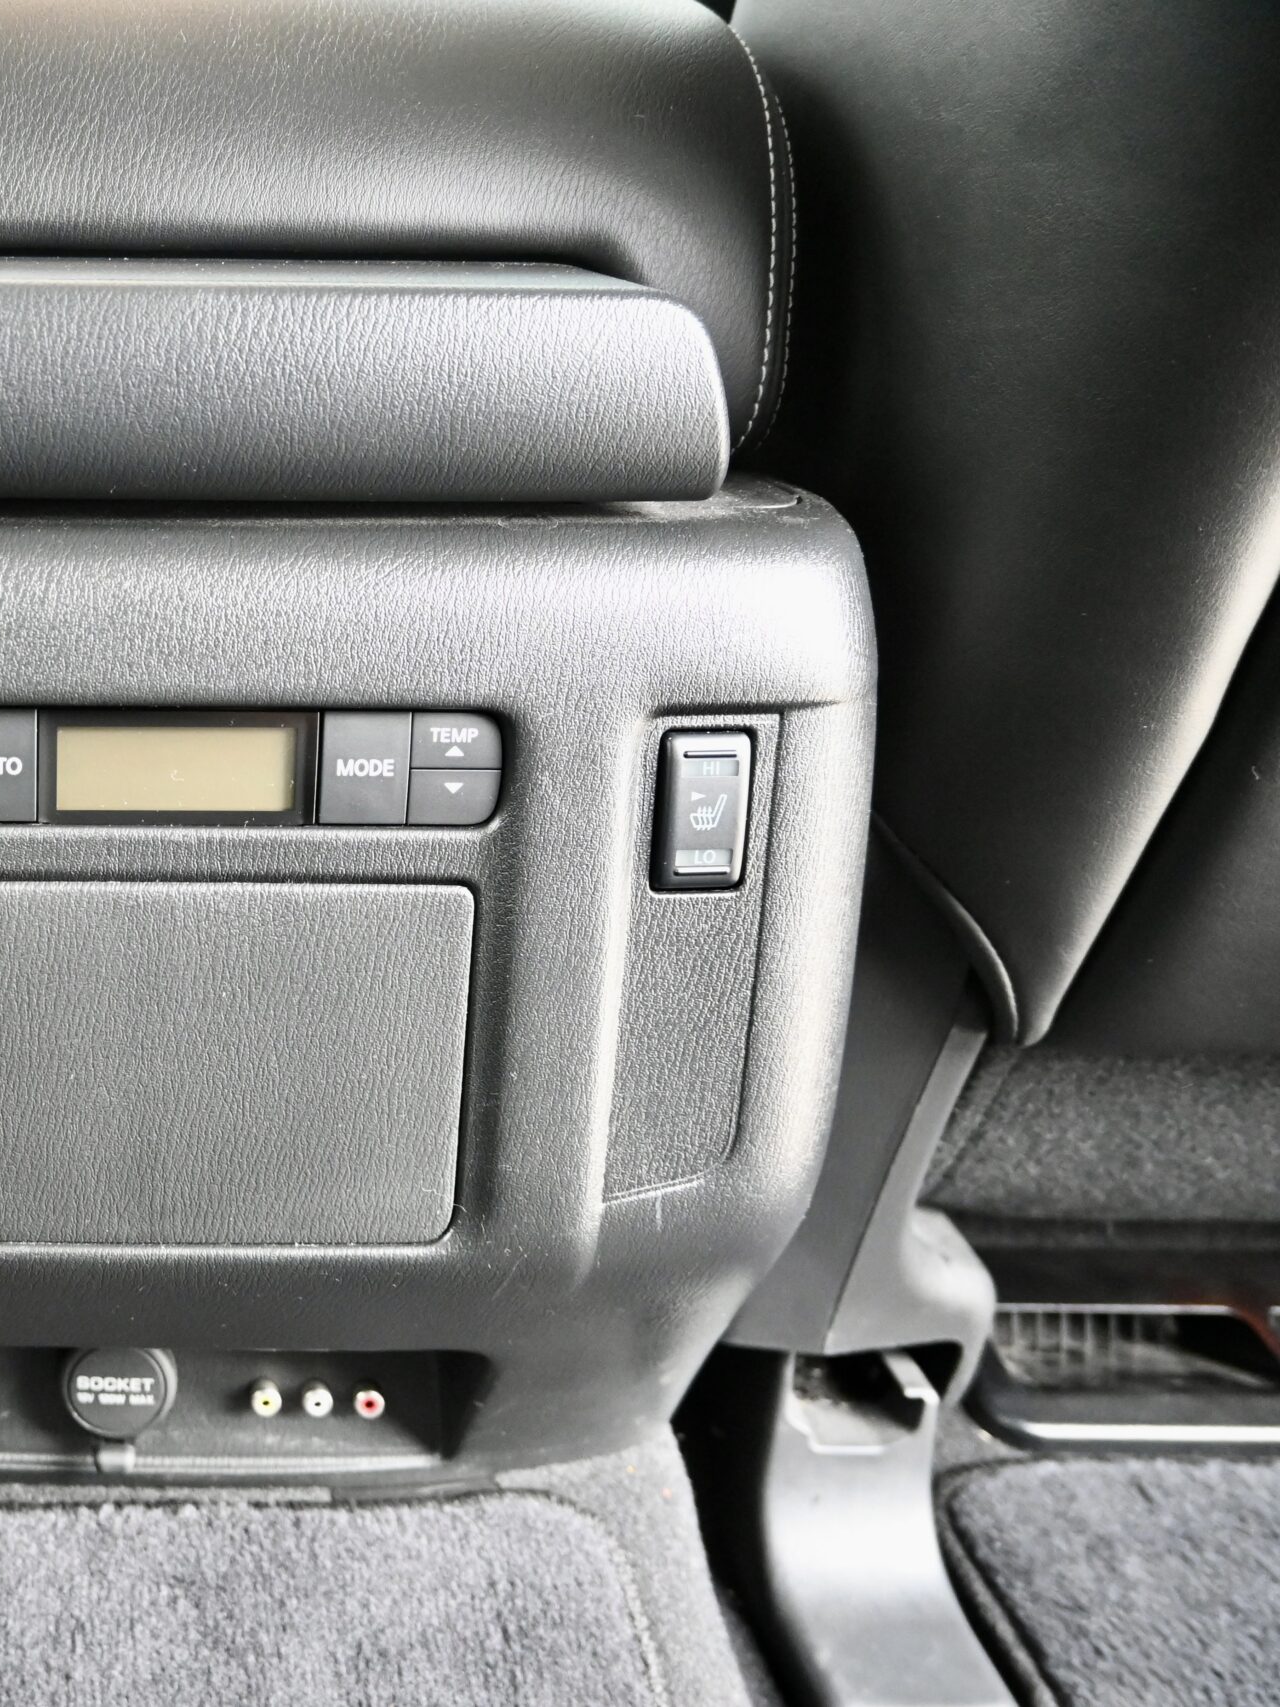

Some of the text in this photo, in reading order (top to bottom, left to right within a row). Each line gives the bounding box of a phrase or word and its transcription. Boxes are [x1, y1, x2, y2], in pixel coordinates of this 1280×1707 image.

[430, 727, 479, 743] TEMP
[336, 758, 395, 777] MODE
[703, 761, 720, 776] HI
[694, 850, 716, 865] LO
[76, 1375, 155, 1393] SOCKET
